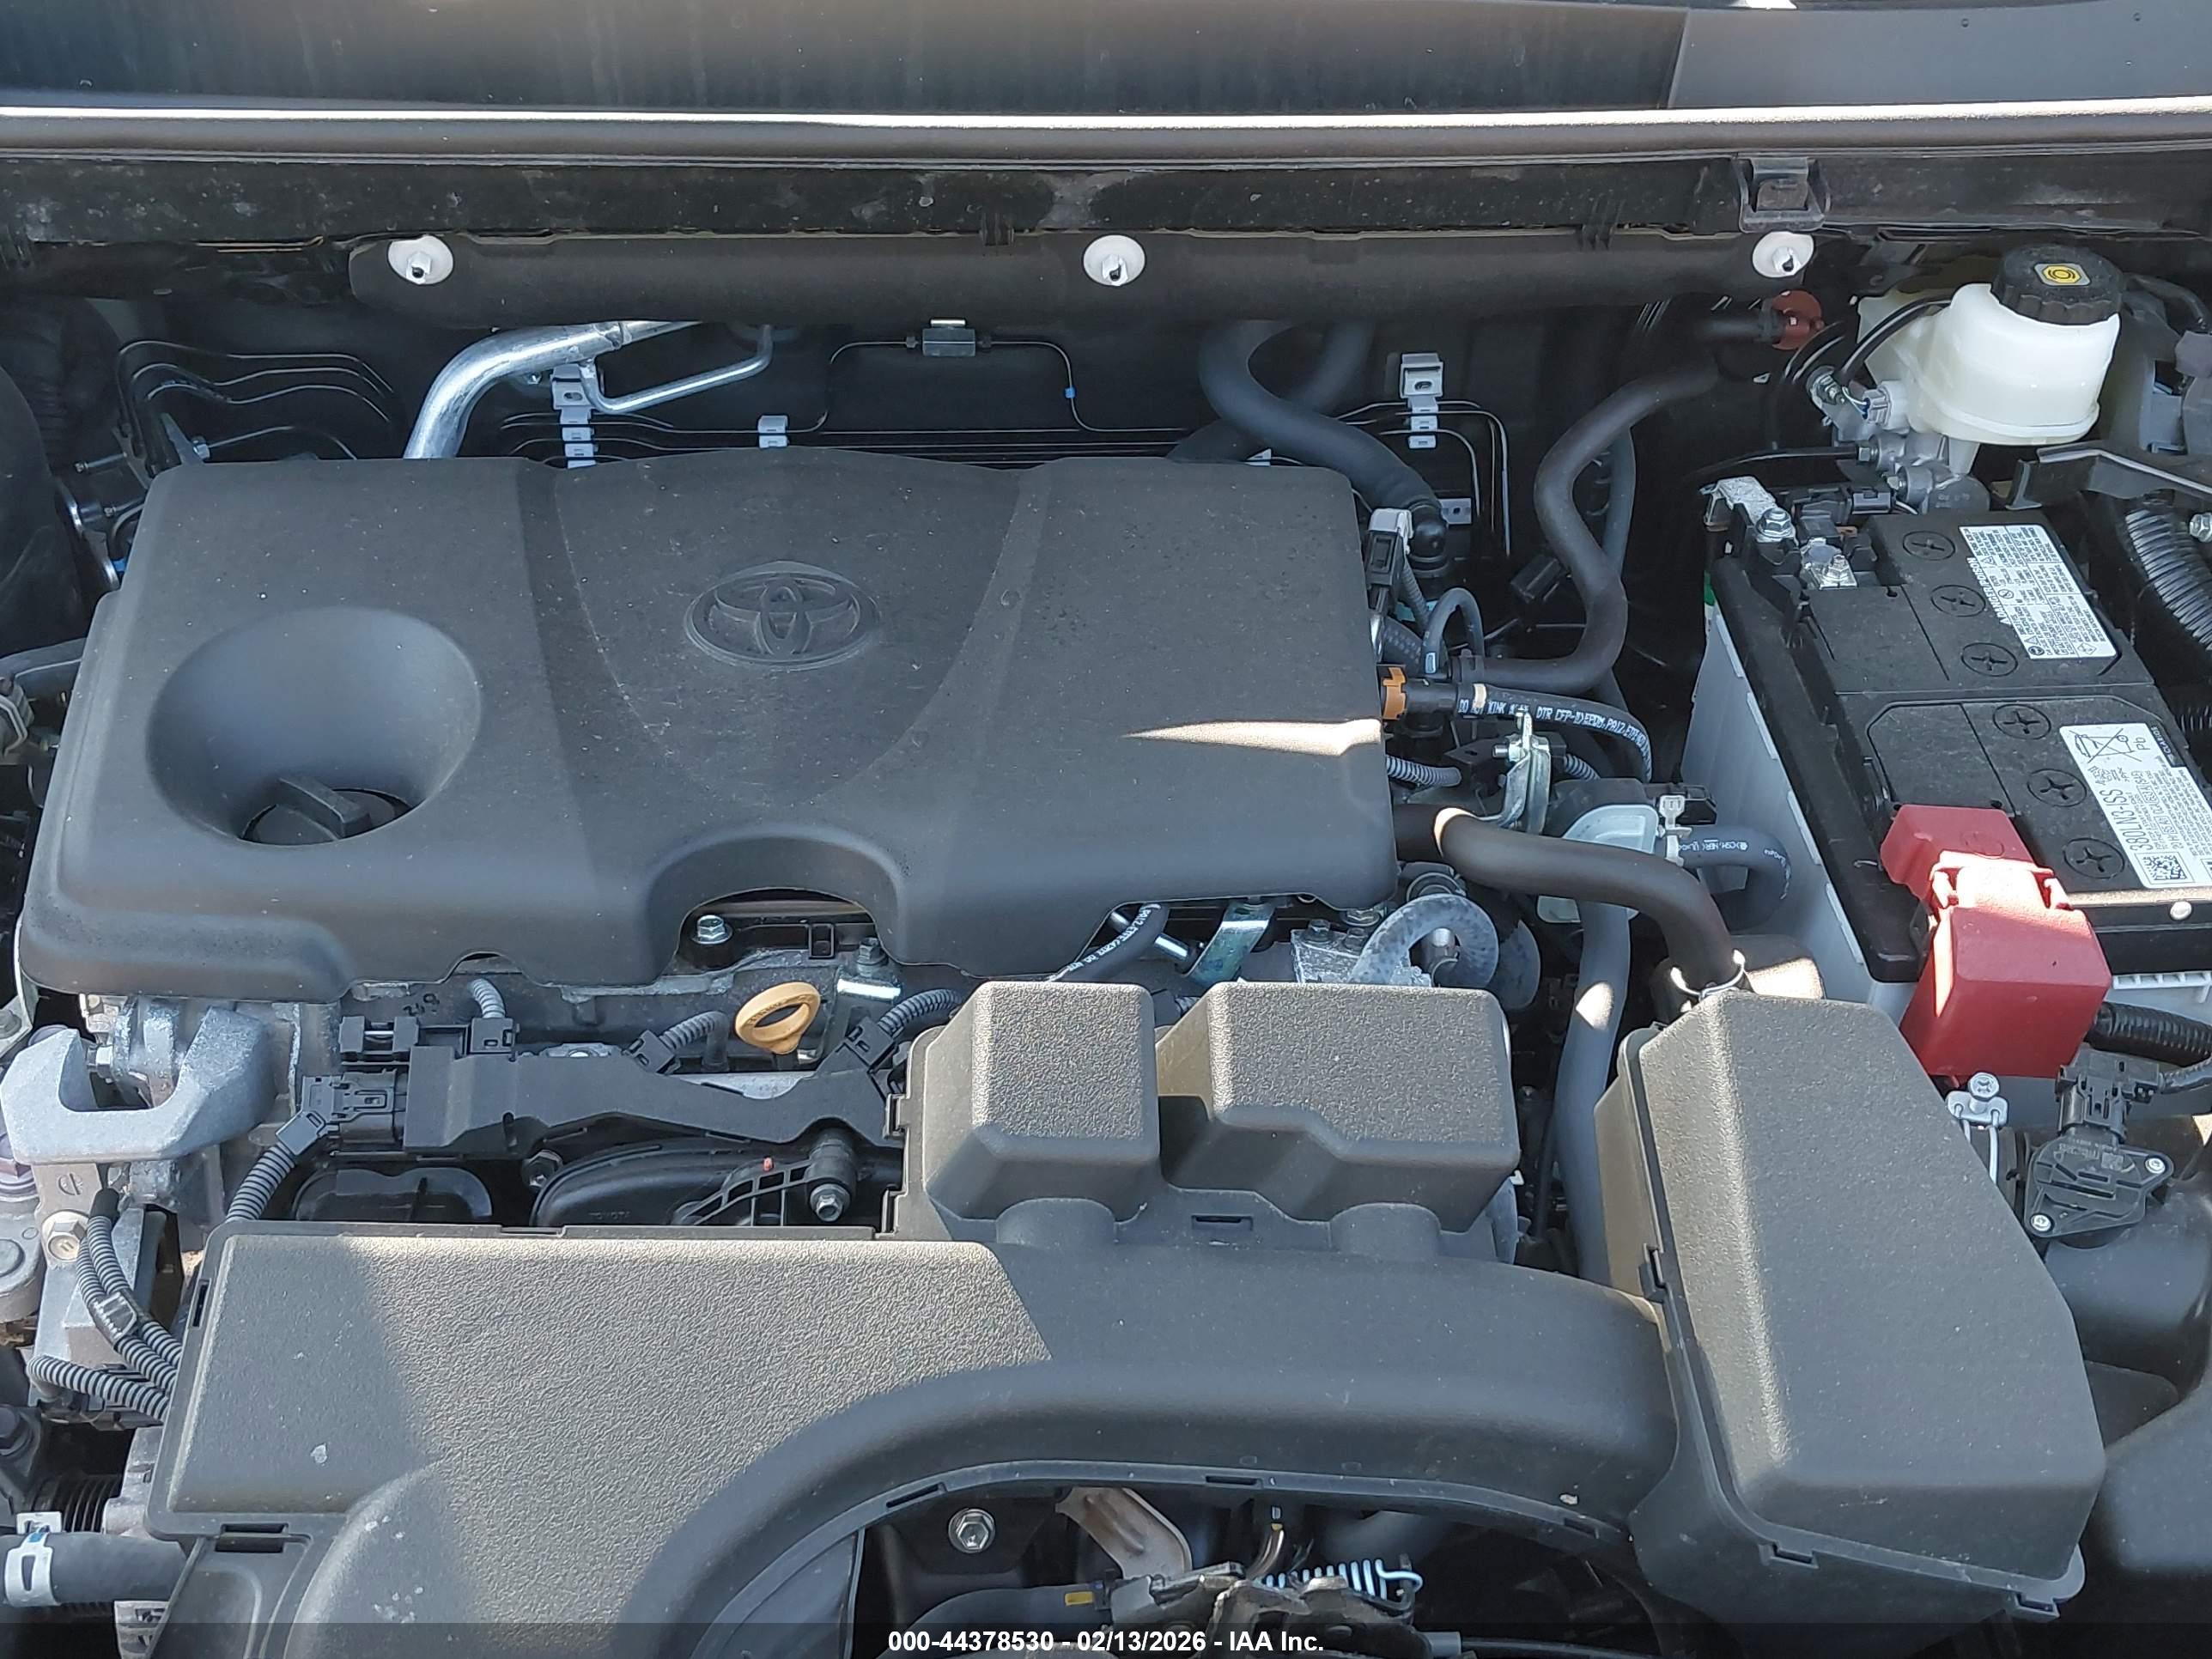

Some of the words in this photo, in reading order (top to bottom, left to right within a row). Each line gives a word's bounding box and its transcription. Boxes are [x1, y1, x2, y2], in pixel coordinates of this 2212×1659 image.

[1966, 557, 2008, 618] DANGER/POISON
[2135, 737, 2151, 750] Pb
[2151, 726, 2172, 753] CLARIOS
[2099, 789, 2154, 851] 380LN3-ISS
